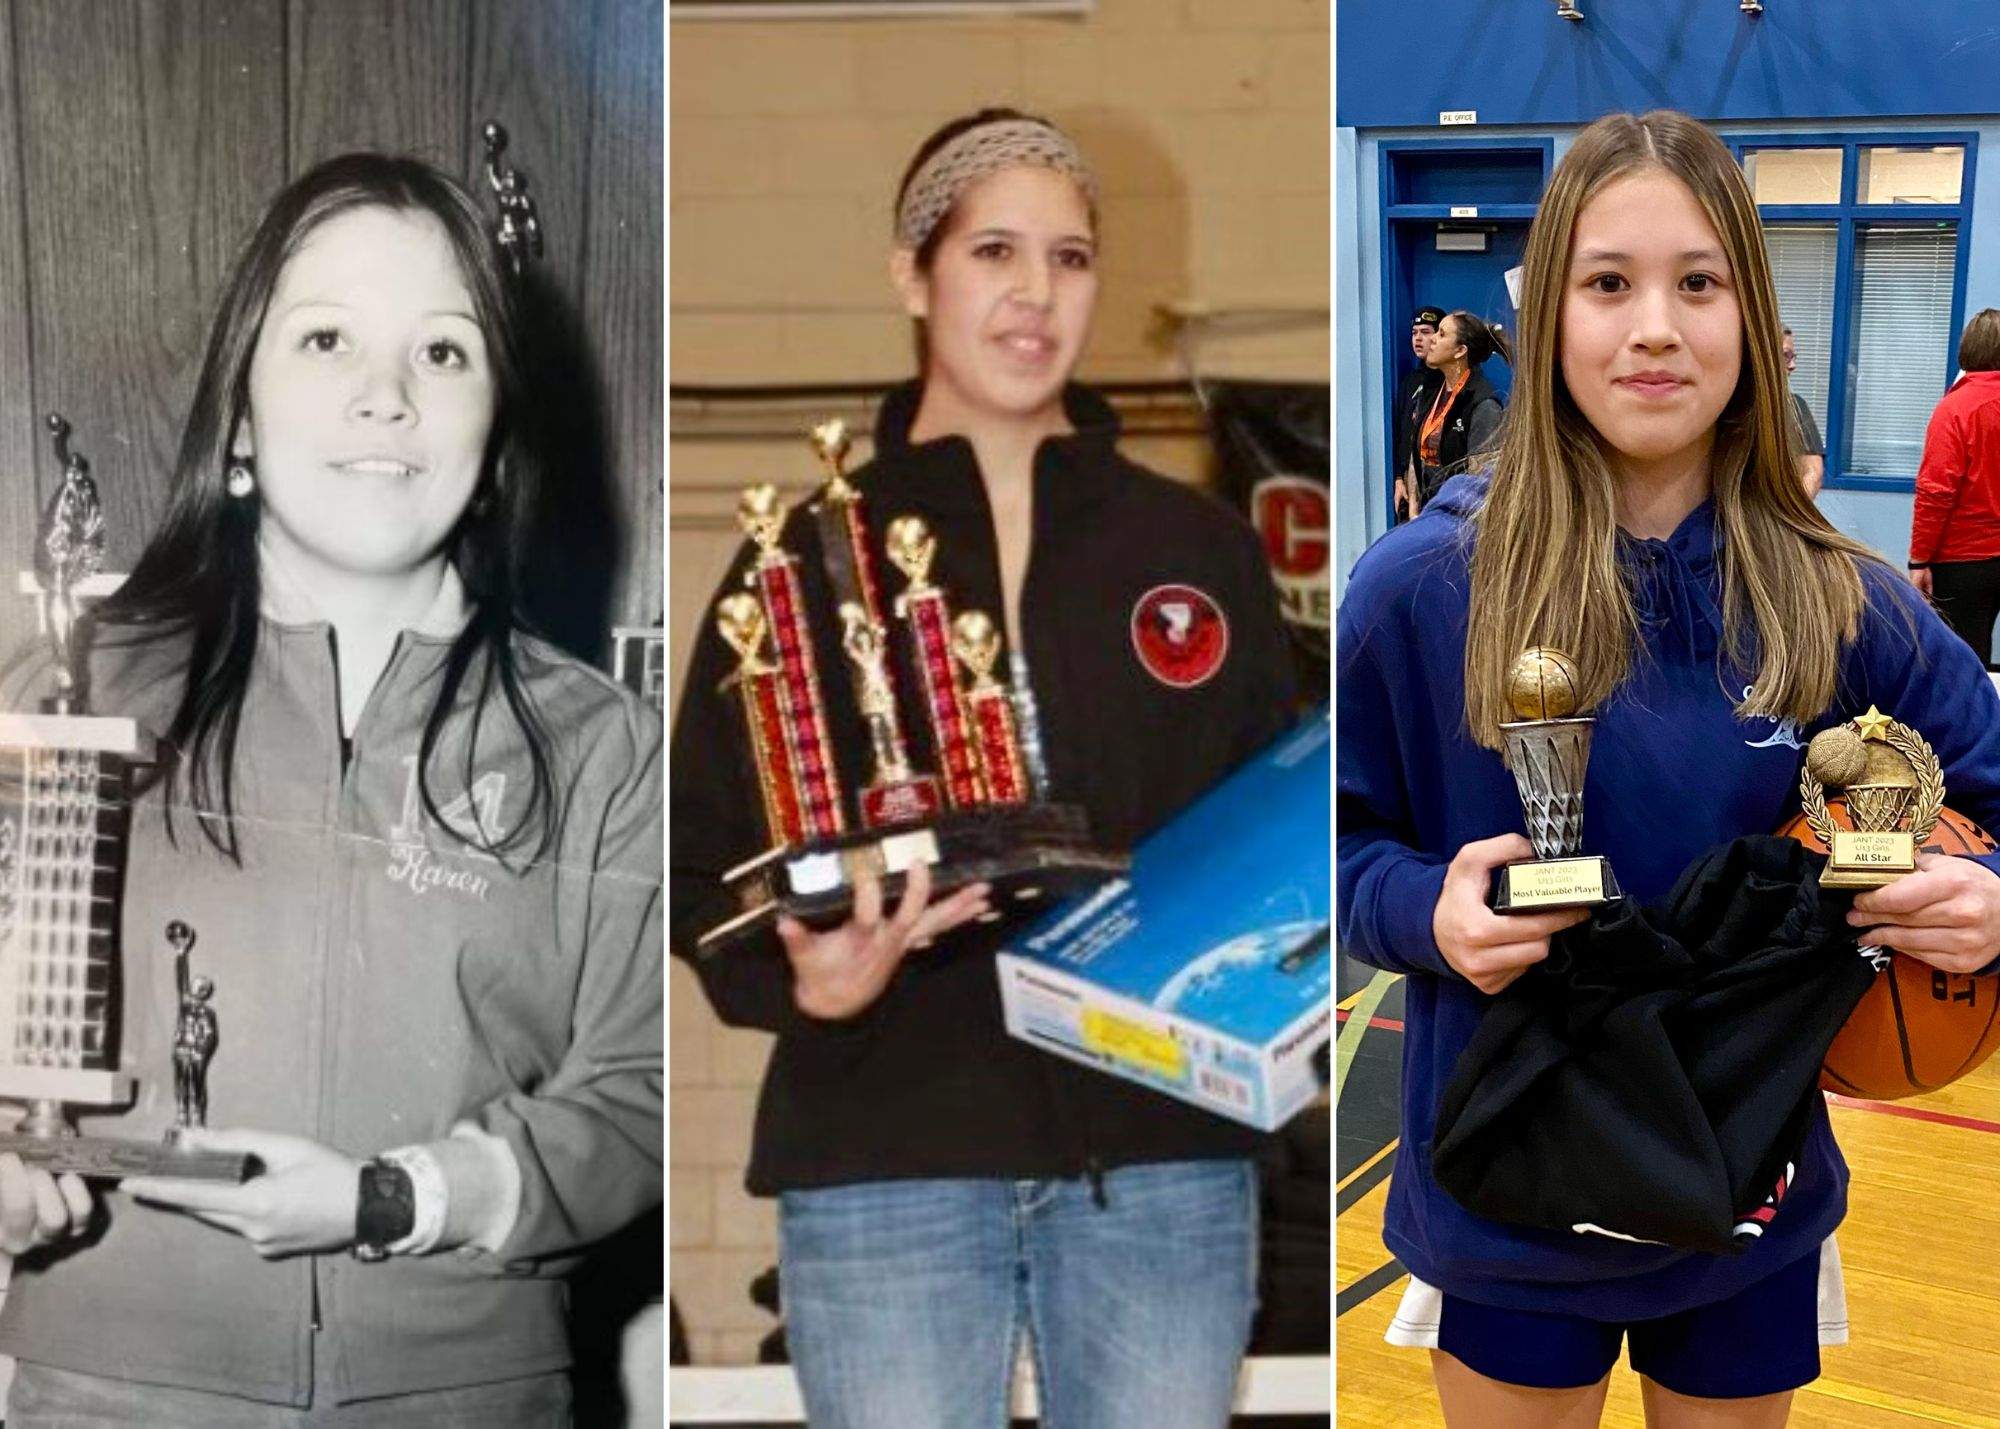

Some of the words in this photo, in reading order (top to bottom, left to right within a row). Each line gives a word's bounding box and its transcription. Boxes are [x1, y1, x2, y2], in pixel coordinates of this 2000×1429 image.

[390, 755, 506, 863] 14
[1853, 836, 1873, 844] JANT
[1875, 837, 1895, 845] 2023
[1855, 845, 1871, 853] U13
[1855, 853, 1868, 862] All
[1870, 853, 1892, 862] Star
[387, 848, 490, 898] Karen
[1534, 866, 1555, 876] JANT
[1557, 865, 1578, 875] 2023
[1537, 877, 1554, 886] U13
[1555, 875, 1574, 884] Girls
[1512, 889, 1534, 899] Most
[1535, 886, 1573, 897] Valuable
[1574, 884, 1601, 896] Player
